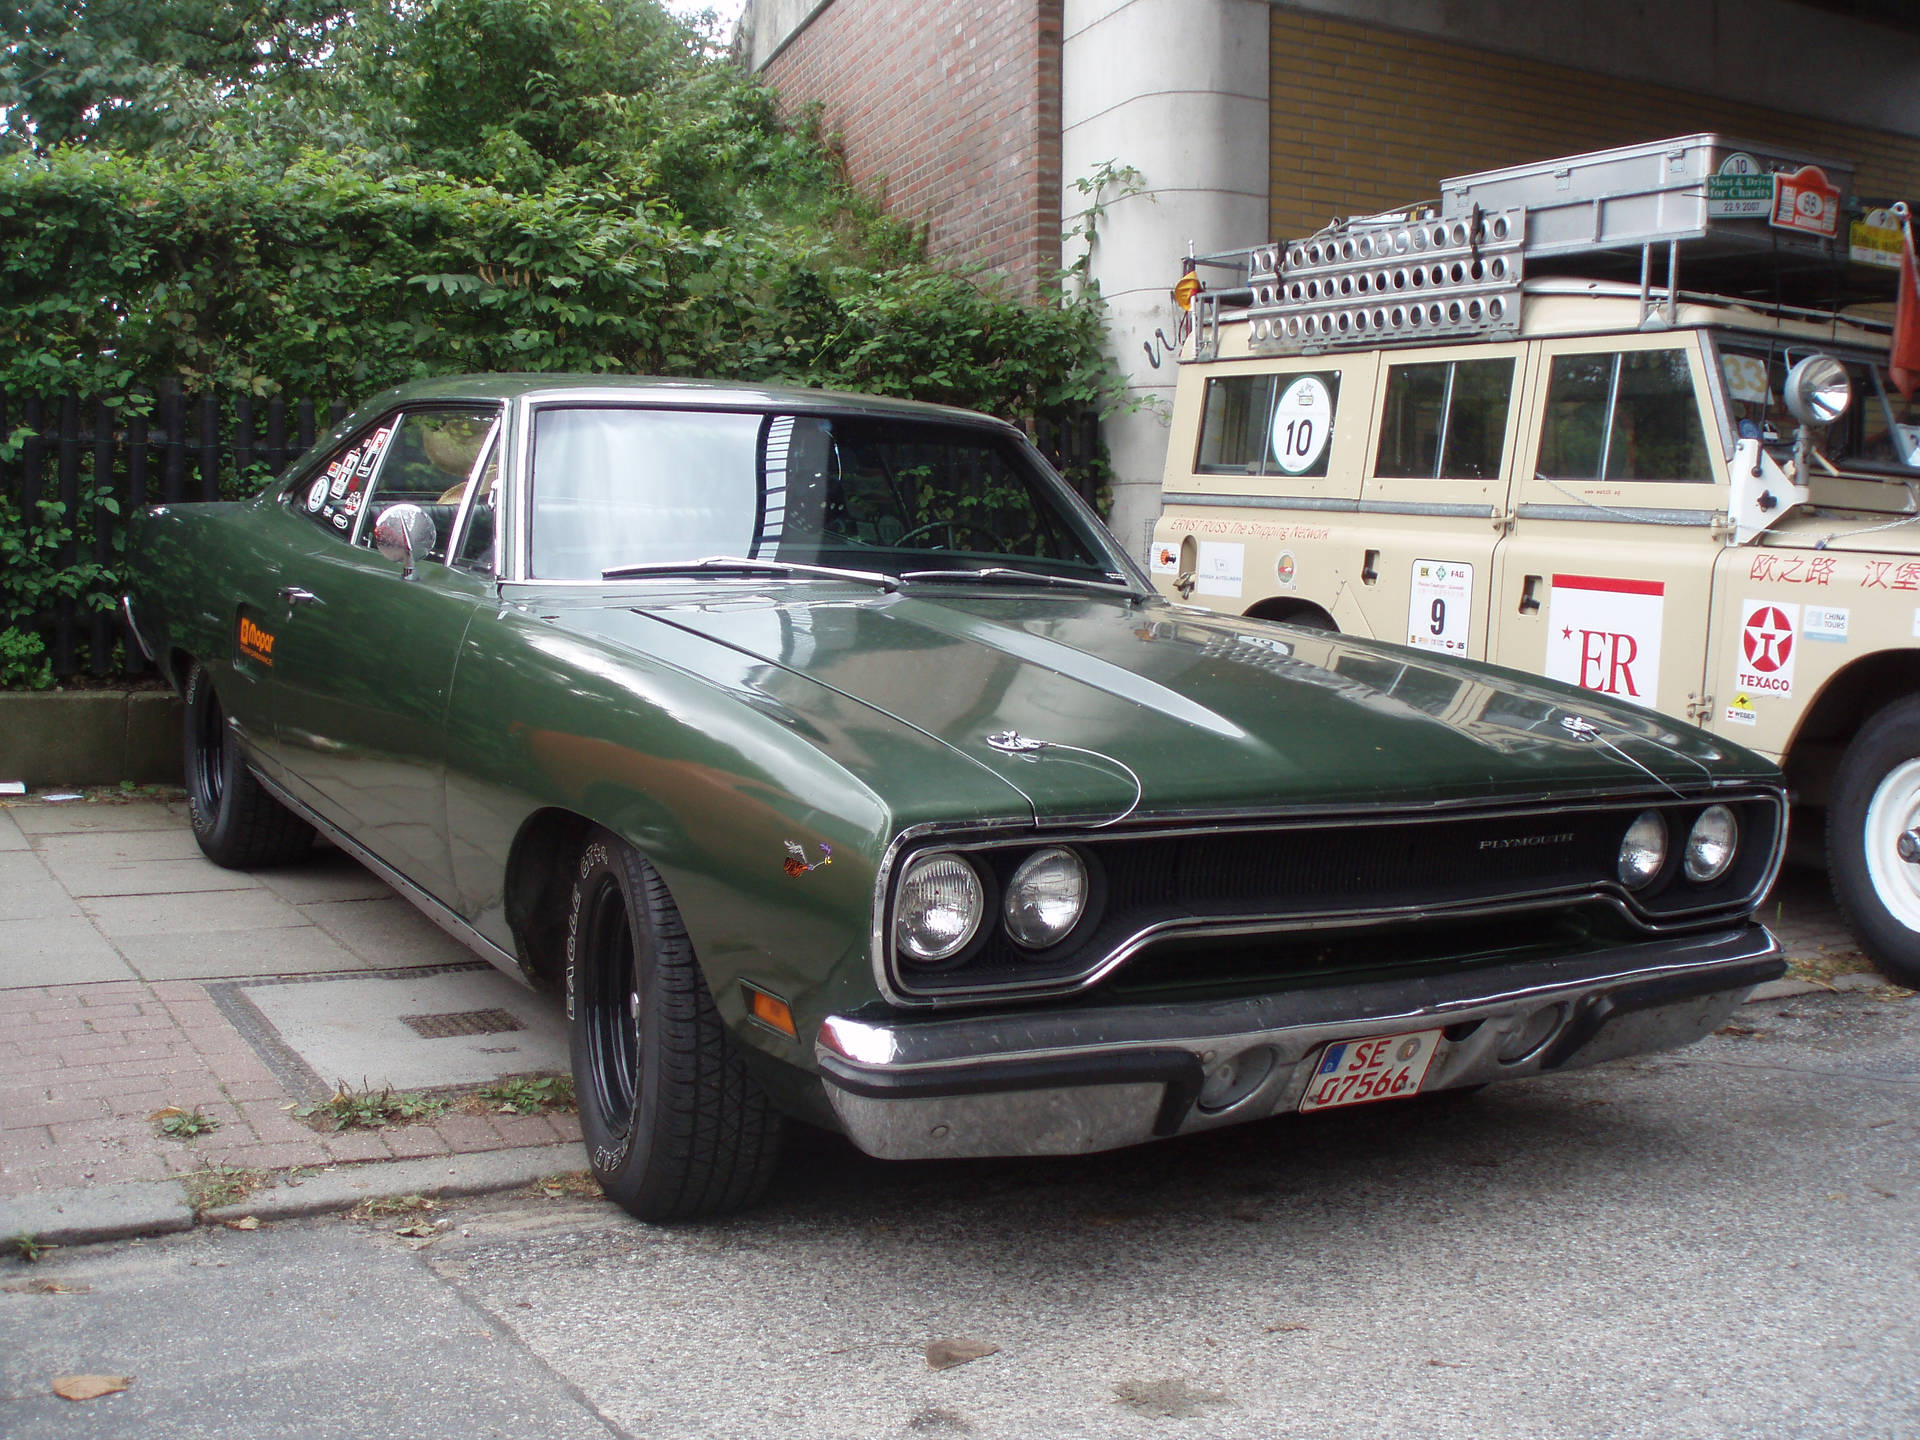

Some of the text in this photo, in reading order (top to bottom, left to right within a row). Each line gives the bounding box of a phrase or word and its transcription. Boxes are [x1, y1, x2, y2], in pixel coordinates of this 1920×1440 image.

[1735, 159, 1748, 173] 10
[1710, 177, 1733, 187] Meet
[1735, 177, 1745, 187] &
[1710, 187, 1771, 199] for Charity
[1286, 419, 1313, 457] 10
[1170, 518, 1331, 541] ERNST RUSS The Shipping Network
[1450, 570, 1465, 579] FAG
[1750, 553, 1837, 586] 欧之路
[1430, 598, 1446, 636] 9
[1824, 612, 1847, 622] CHINA
[1824, 621, 1846, 630] TOURS
[248, 622, 275, 653] Mopar
[1578, 628, 1641, 697] ER
[1739, 673, 1790, 693] TEXACO
[1479, 832, 1575, 850] PLYMOUTH
[1348, 1039, 1393, 1072] SE
[1316, 1065, 1411, 1105] 07566
